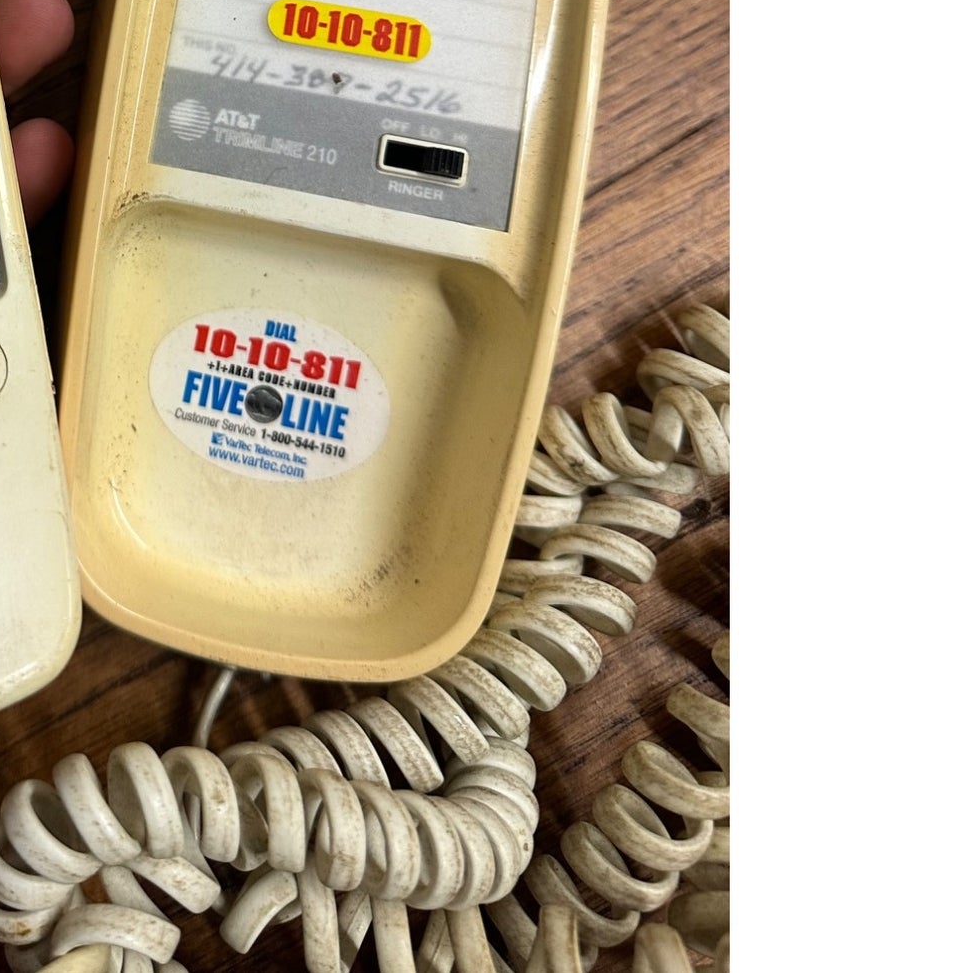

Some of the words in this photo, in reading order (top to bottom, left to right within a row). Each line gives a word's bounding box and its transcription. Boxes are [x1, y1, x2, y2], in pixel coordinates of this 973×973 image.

[283, 3, 422, 58] 10-10-811
[214, 108, 261, 131] AT&T
[380, 118, 410, 133] OFF
[213, 128, 303, 159] TRIMLINE
[306, 146, 337, 166] 210
[387, 180, 444, 201] RINGER
[264, 319, 297, 343] DIAL
[194, 324, 362, 390] 10-10-811
[182, 369, 247, 417] FIVE
[280, 393, 350, 441] LINE
[174, 407, 220, 429] Customer
[222, 417, 256, 438] Service
[260, 427, 346, 459] 1-800-544-1510
[208, 445, 305, 479] www.vartec.com
